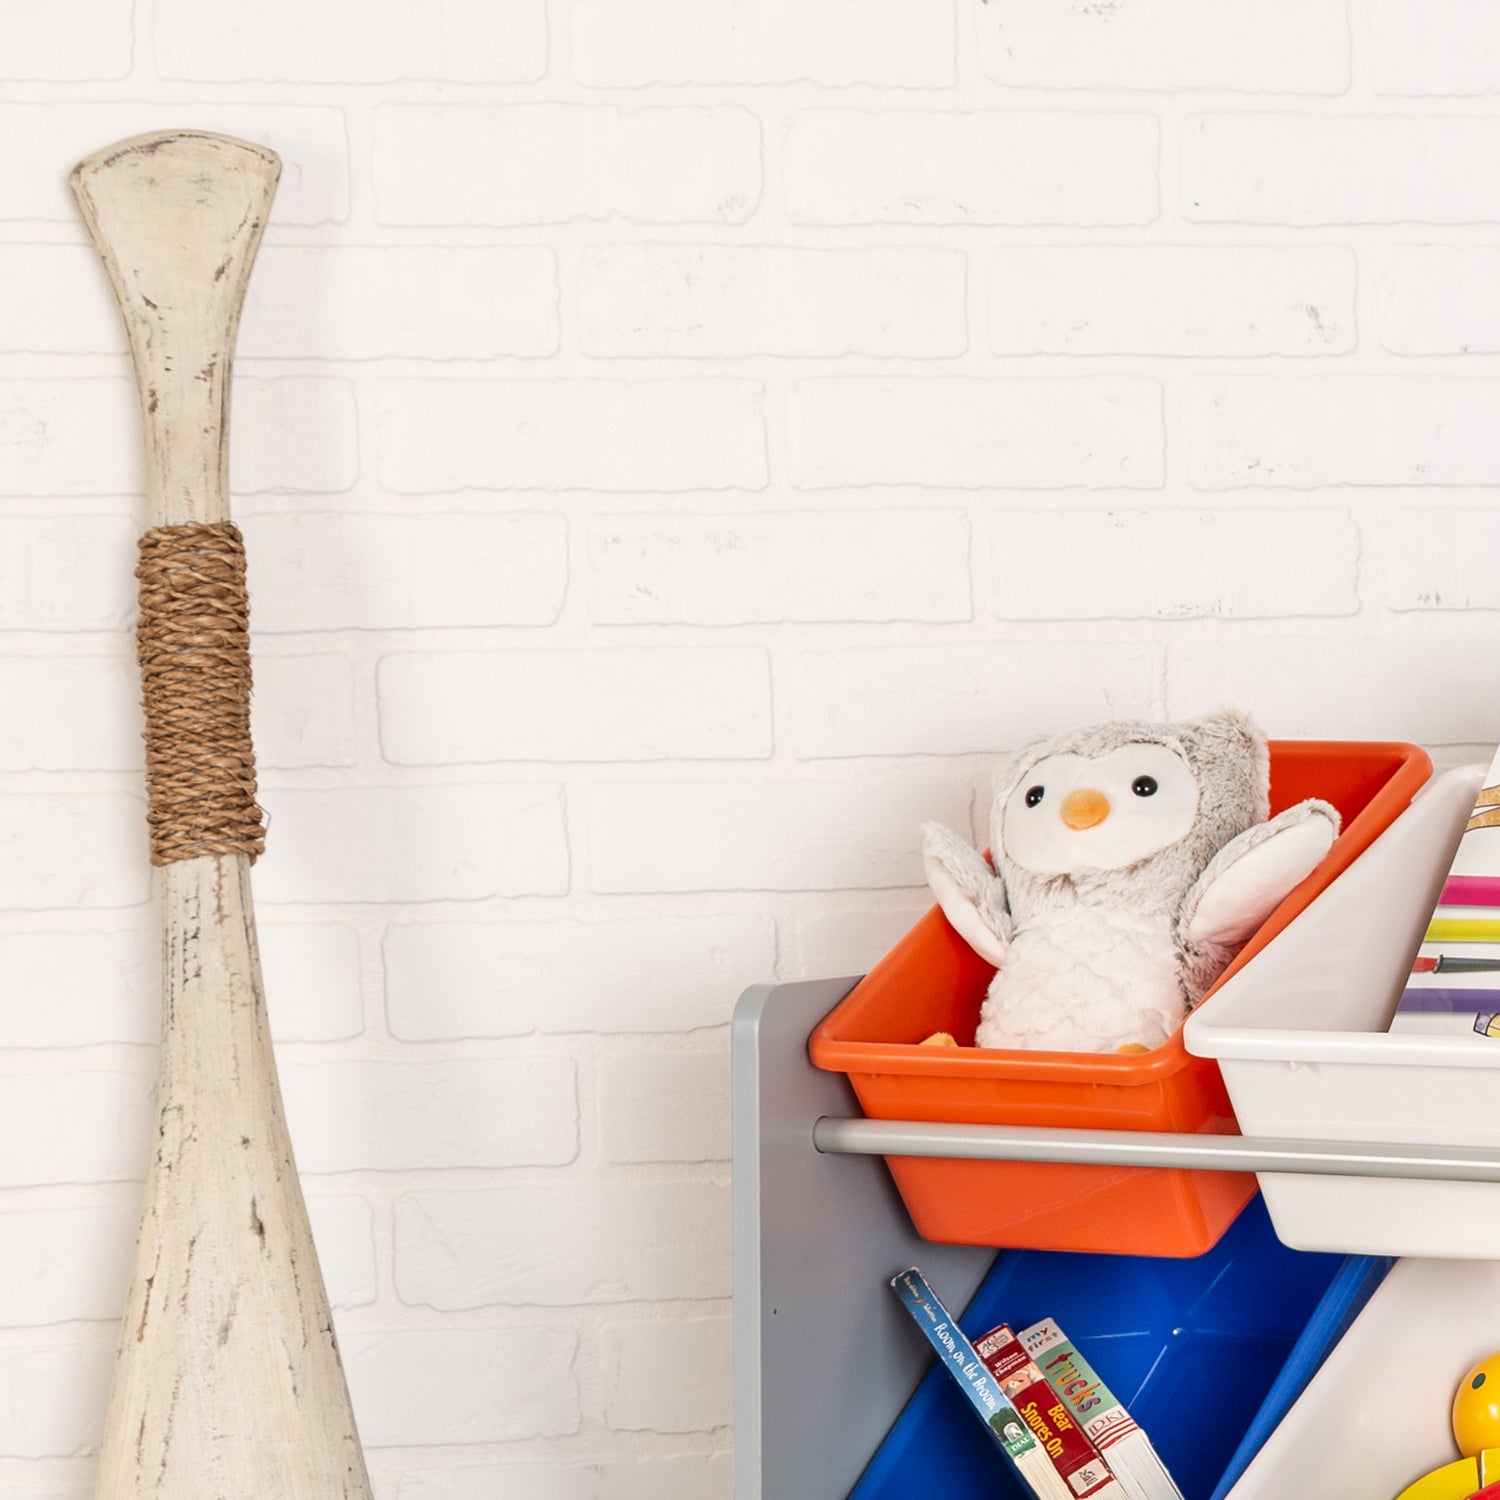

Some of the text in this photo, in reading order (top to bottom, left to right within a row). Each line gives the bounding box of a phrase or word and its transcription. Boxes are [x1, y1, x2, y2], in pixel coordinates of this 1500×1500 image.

[934, 1322, 956, 1353] Room
[952, 1351, 965, 1366] on
[962, 1362, 979, 1380] the
[972, 1377, 996, 1410] Broom
[1044, 1348, 1102, 1414] trucks
[1011, 1437, 1029, 1451] DIAL
[1020, 1402, 1064, 1458] Snores On
[1047, 1402, 1073, 1431] Bear
